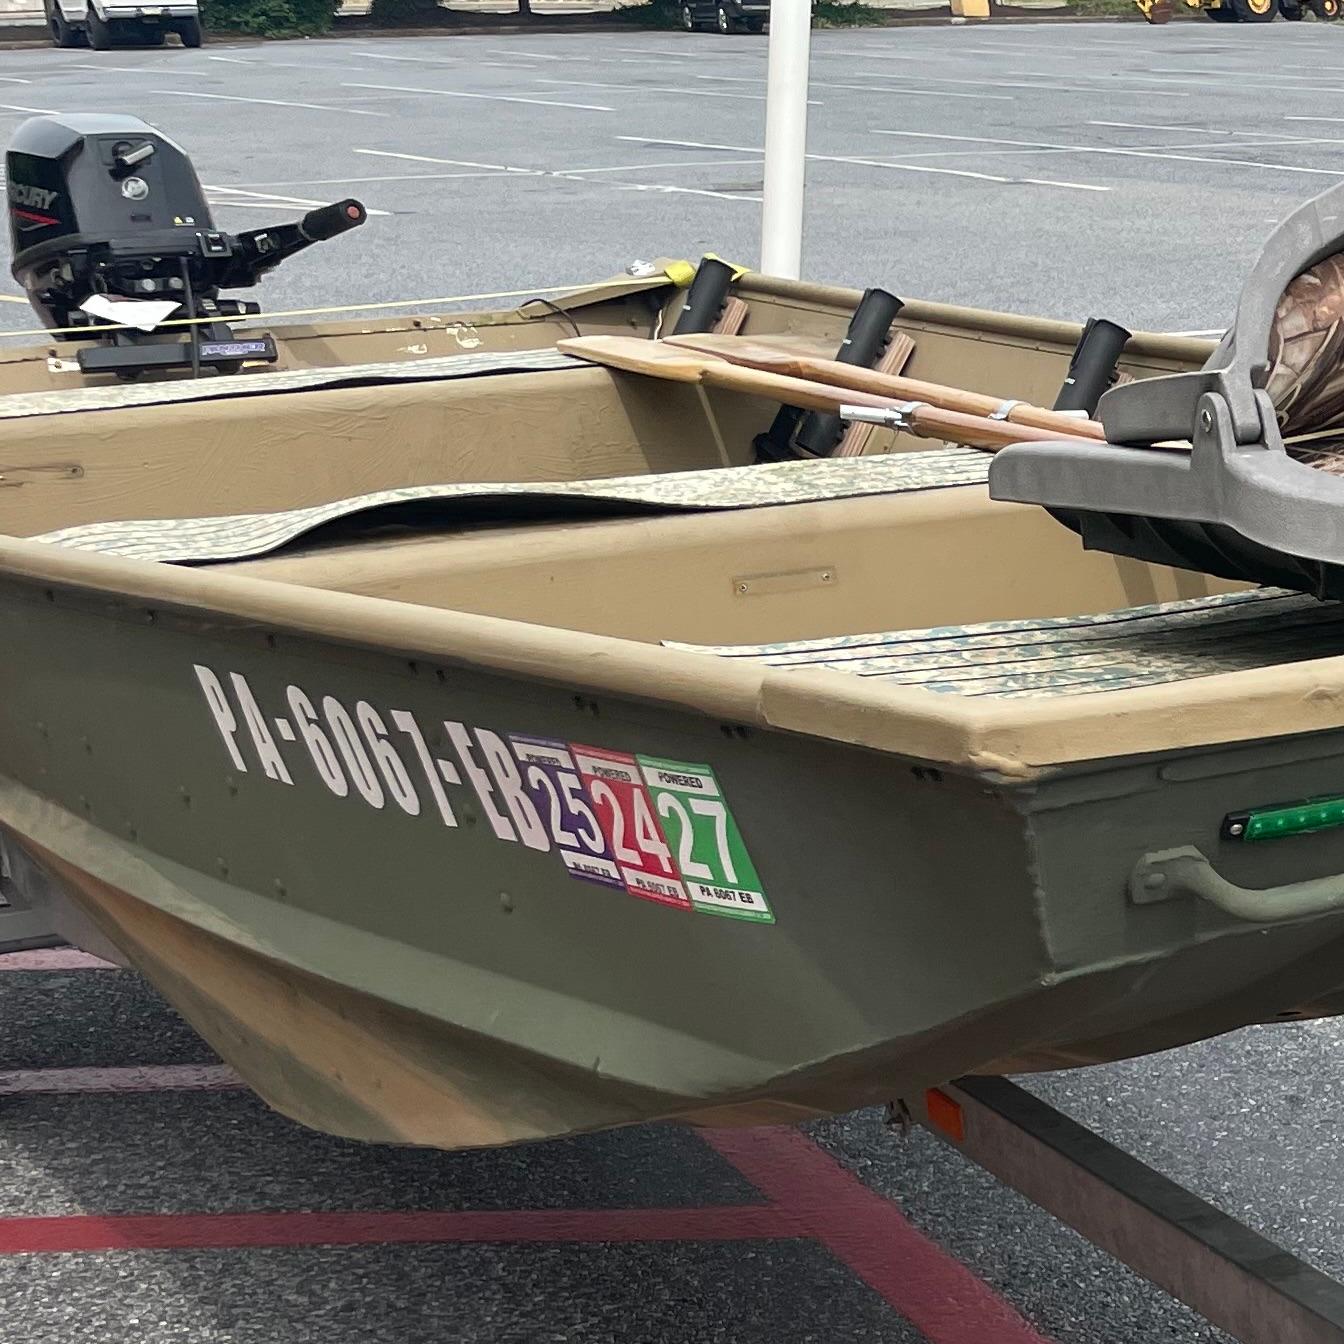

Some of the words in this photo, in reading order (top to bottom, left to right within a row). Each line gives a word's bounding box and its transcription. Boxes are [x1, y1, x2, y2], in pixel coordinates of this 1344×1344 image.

[193, 664, 551, 853] PA-6067-EB
[592, 765, 632, 782] POWERED
[657, 771, 703, 789] POWERED
[527, 765, 605, 854] 25
[590, 779, 673, 874] 24
[657, 791, 738, 884] 27
[700, 885, 713, 897] PA
[714, 888, 737, 902] 6067
[740, 891, 754, 904] EB
